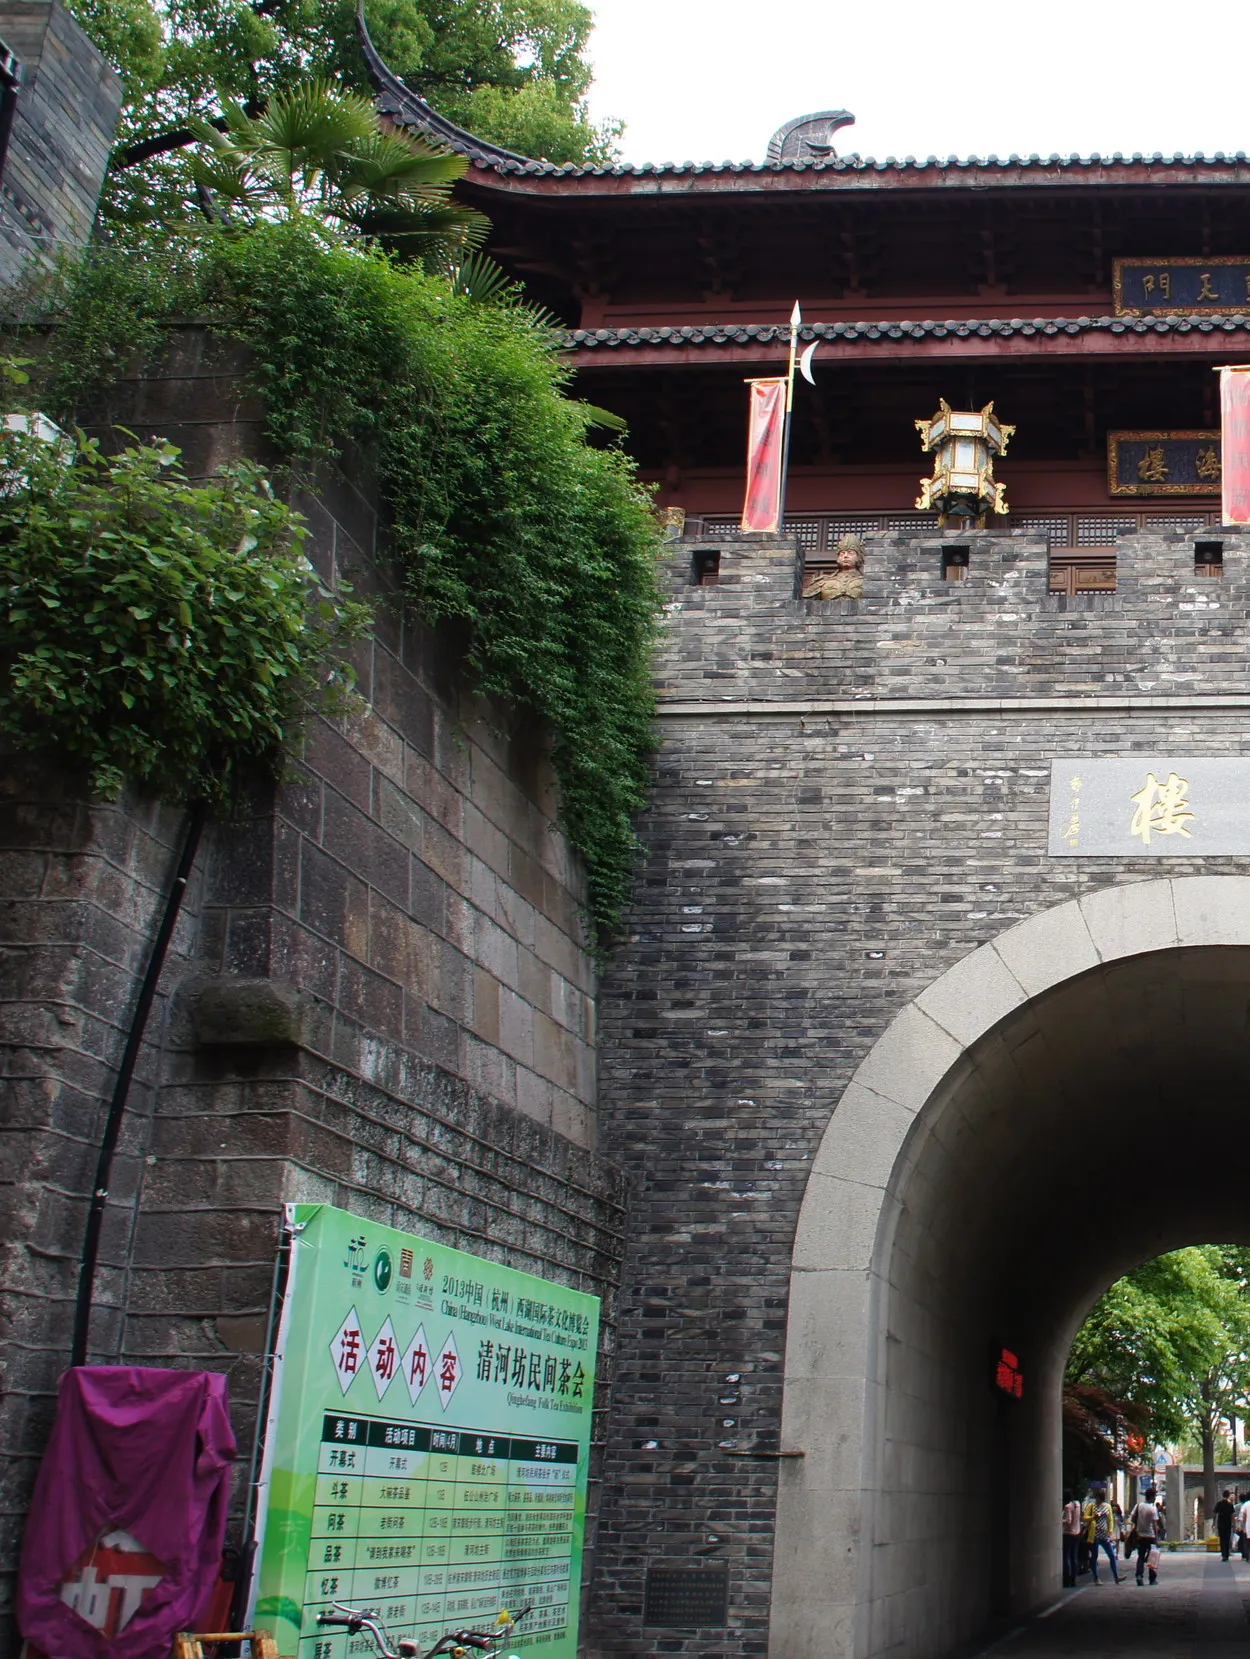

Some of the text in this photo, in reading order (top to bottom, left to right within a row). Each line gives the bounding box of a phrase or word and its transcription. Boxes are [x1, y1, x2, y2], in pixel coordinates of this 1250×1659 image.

[440, 1299, 457, 1317] China
[489, 1313, 501, 1329] West
[502, 1317, 513, 1332] Lake
[513, 1320, 541, 1339] International
[338, 1328, 457, 1392] 活动内容
[477, 1339, 586, 1398] 清河坊民间茶会
[507, 1391, 537, 1409] Qinghefang
[538, 1396, 549, 1409] Folk
[385, 1427, 416, 1446] 活动项目
[329, 1450, 356, 1469] 开幕式
[534, 1443, 557, 1459] 主要内容
[389, 1457, 408, 1470] 开幕式
[330, 1481, 349, 1500] 斗茶
[327, 1513, 346, 1531] 问茶
[324, 1544, 342, 1563] 品茶
[321, 1577, 339, 1595] 忆茶
